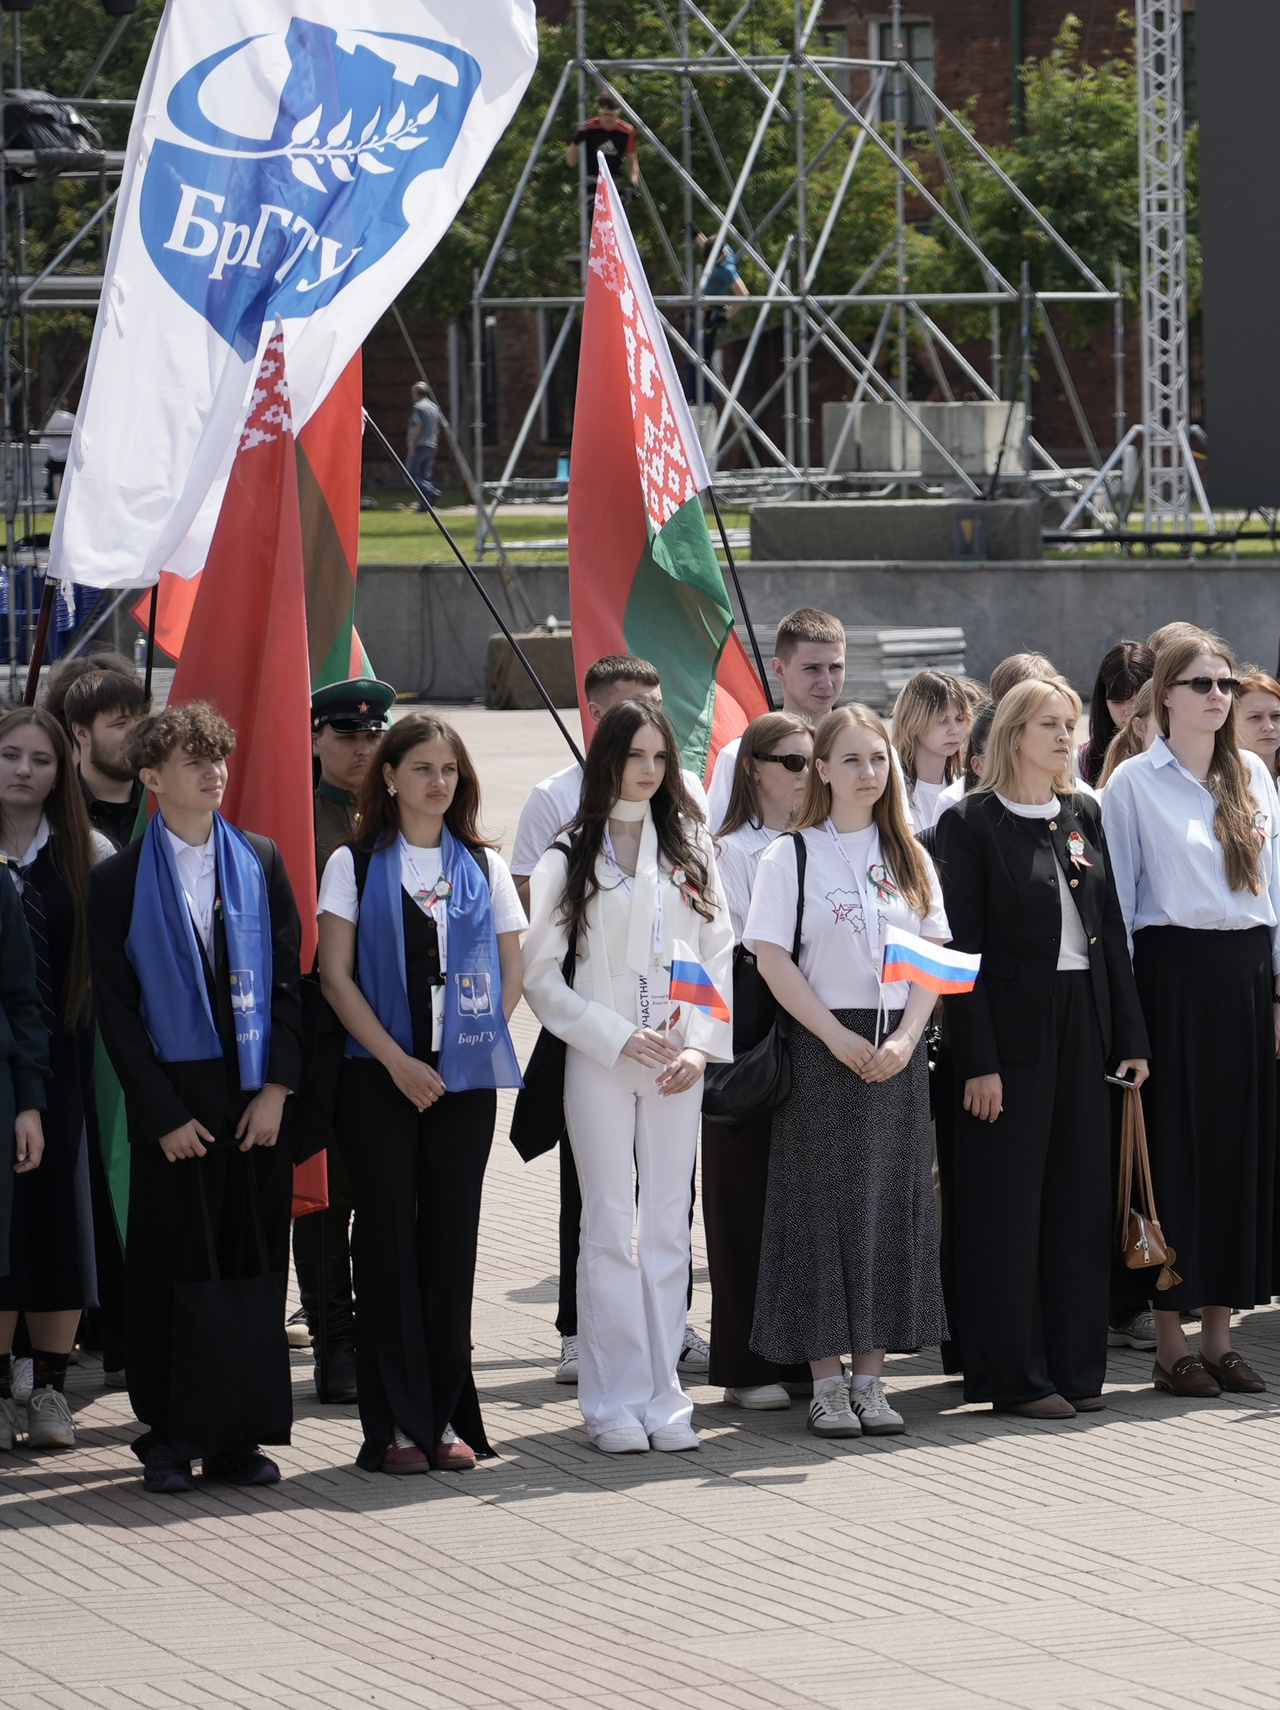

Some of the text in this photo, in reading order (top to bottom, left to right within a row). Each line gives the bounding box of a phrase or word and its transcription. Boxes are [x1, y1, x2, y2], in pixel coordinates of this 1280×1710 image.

[162, 183, 364, 293] БрГТУ
[638, 974, 652, 1029] УЧАСТНИ
[236, 1029, 260, 1045] арГУ
[457, 1030, 497, 1046] БарГУ
